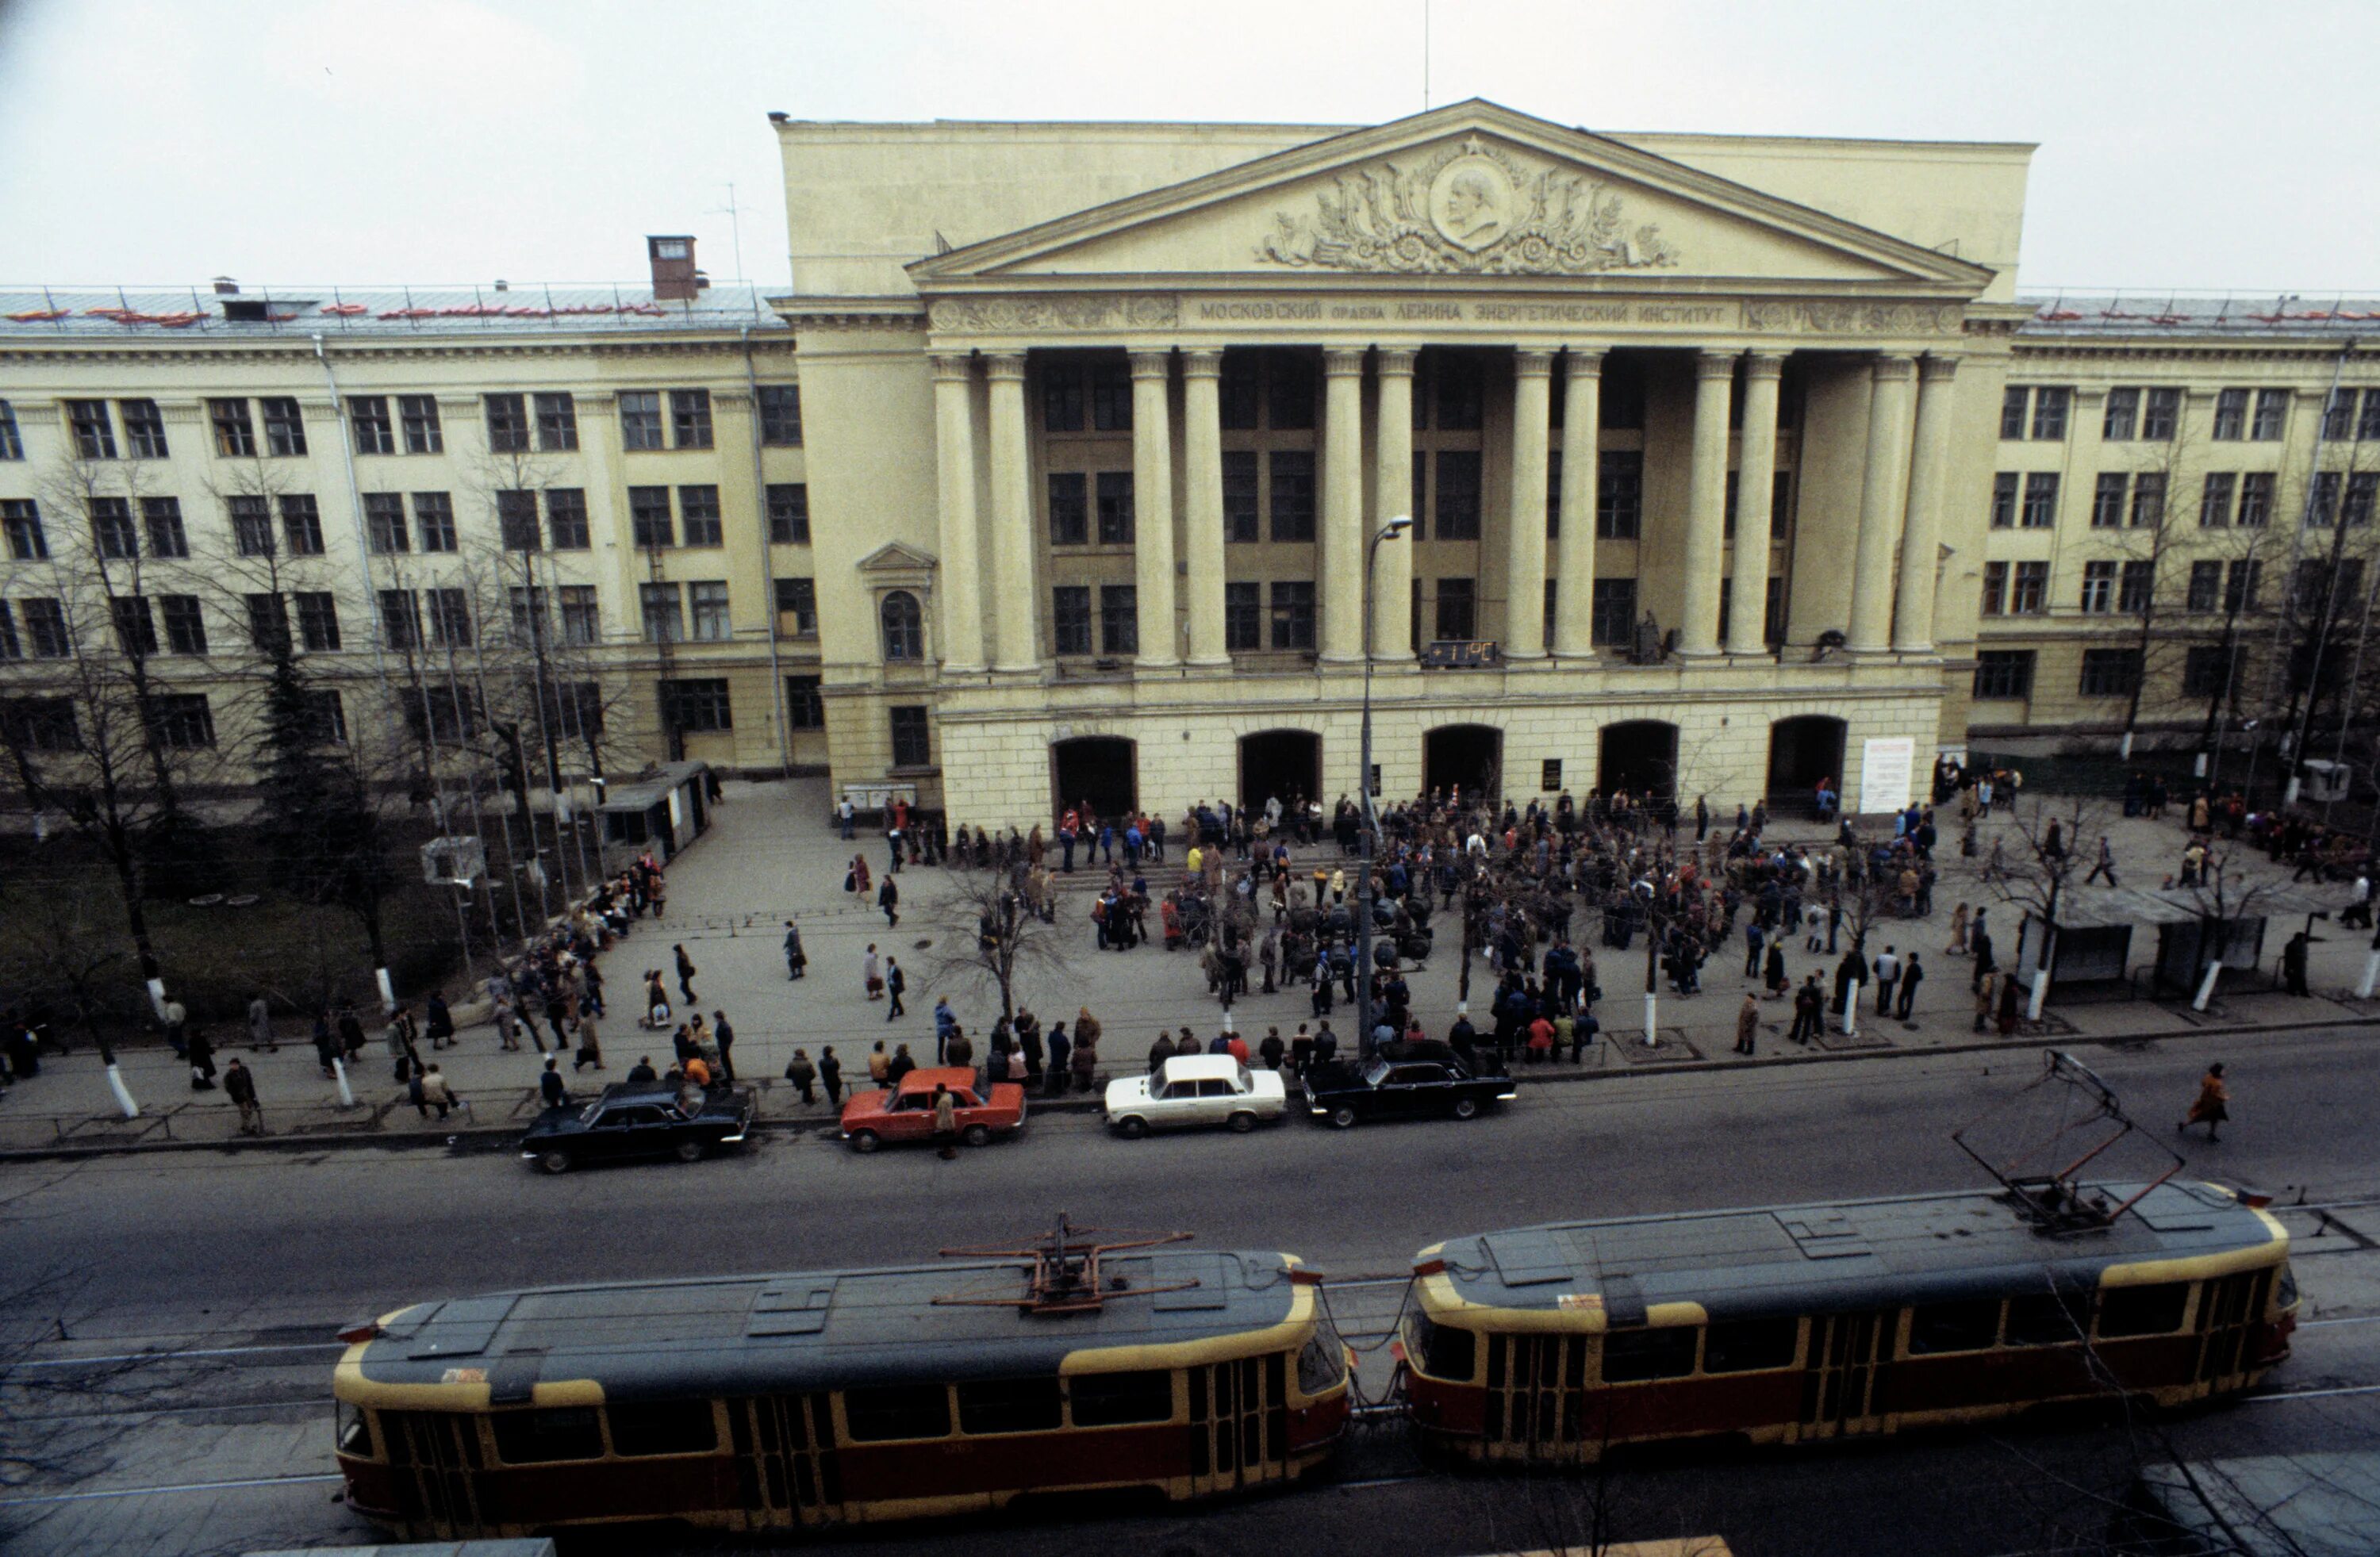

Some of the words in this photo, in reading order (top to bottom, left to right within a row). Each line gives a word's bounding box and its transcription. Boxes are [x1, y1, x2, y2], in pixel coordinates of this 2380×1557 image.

[1200, 301, 1322, 320] МОСКОВСКИЙ
[1395, 303, 1463, 320] ЛЕНИНА
[1474, 302, 1627, 321] ЭНЕРГЕТИЧЕСКИЙ
[1637, 305, 1724, 322] ИНСТИТУТ
